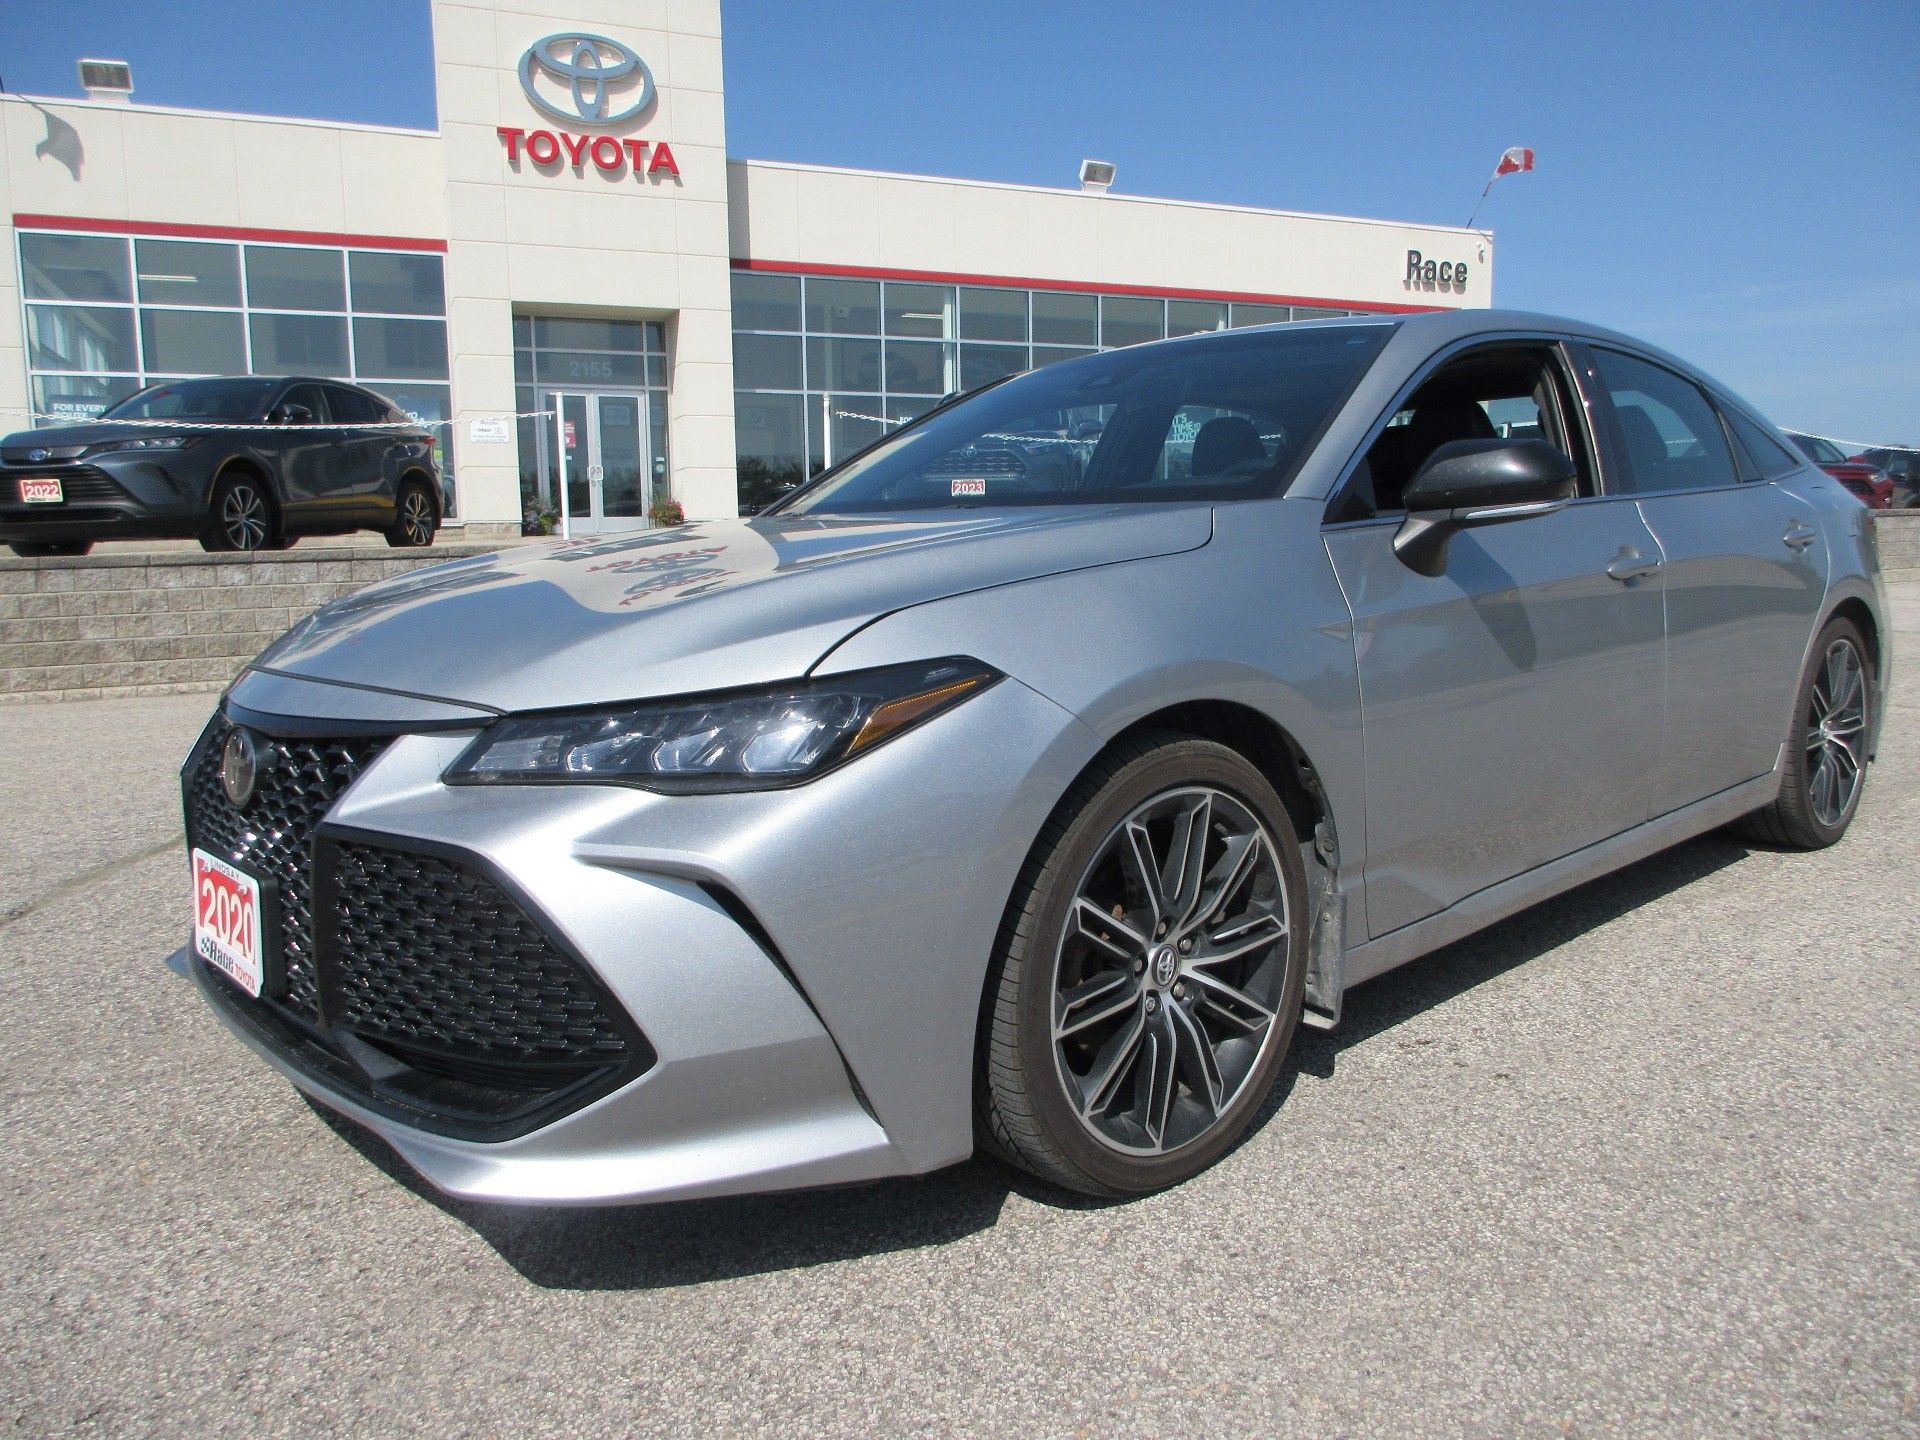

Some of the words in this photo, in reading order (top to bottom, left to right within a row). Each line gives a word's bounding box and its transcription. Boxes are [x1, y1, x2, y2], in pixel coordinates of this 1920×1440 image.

[496, 126, 680, 176] TOYOTA
[1406, 249, 1468, 284] Race
[569, 361, 613, 378] 2155
[53, 403, 75, 412] FOR
[75, 404, 107, 413] EVERY
[1173, 421, 1193, 434] TIME
[25, 484, 60, 498] 2022
[954, 483, 983, 495] 2023
[210, 858, 240, 881] LINDSAY
[202, 877, 256, 965] 2020
[209, 938, 235, 975] Race
[234, 962, 257, 994] TOYOTA
